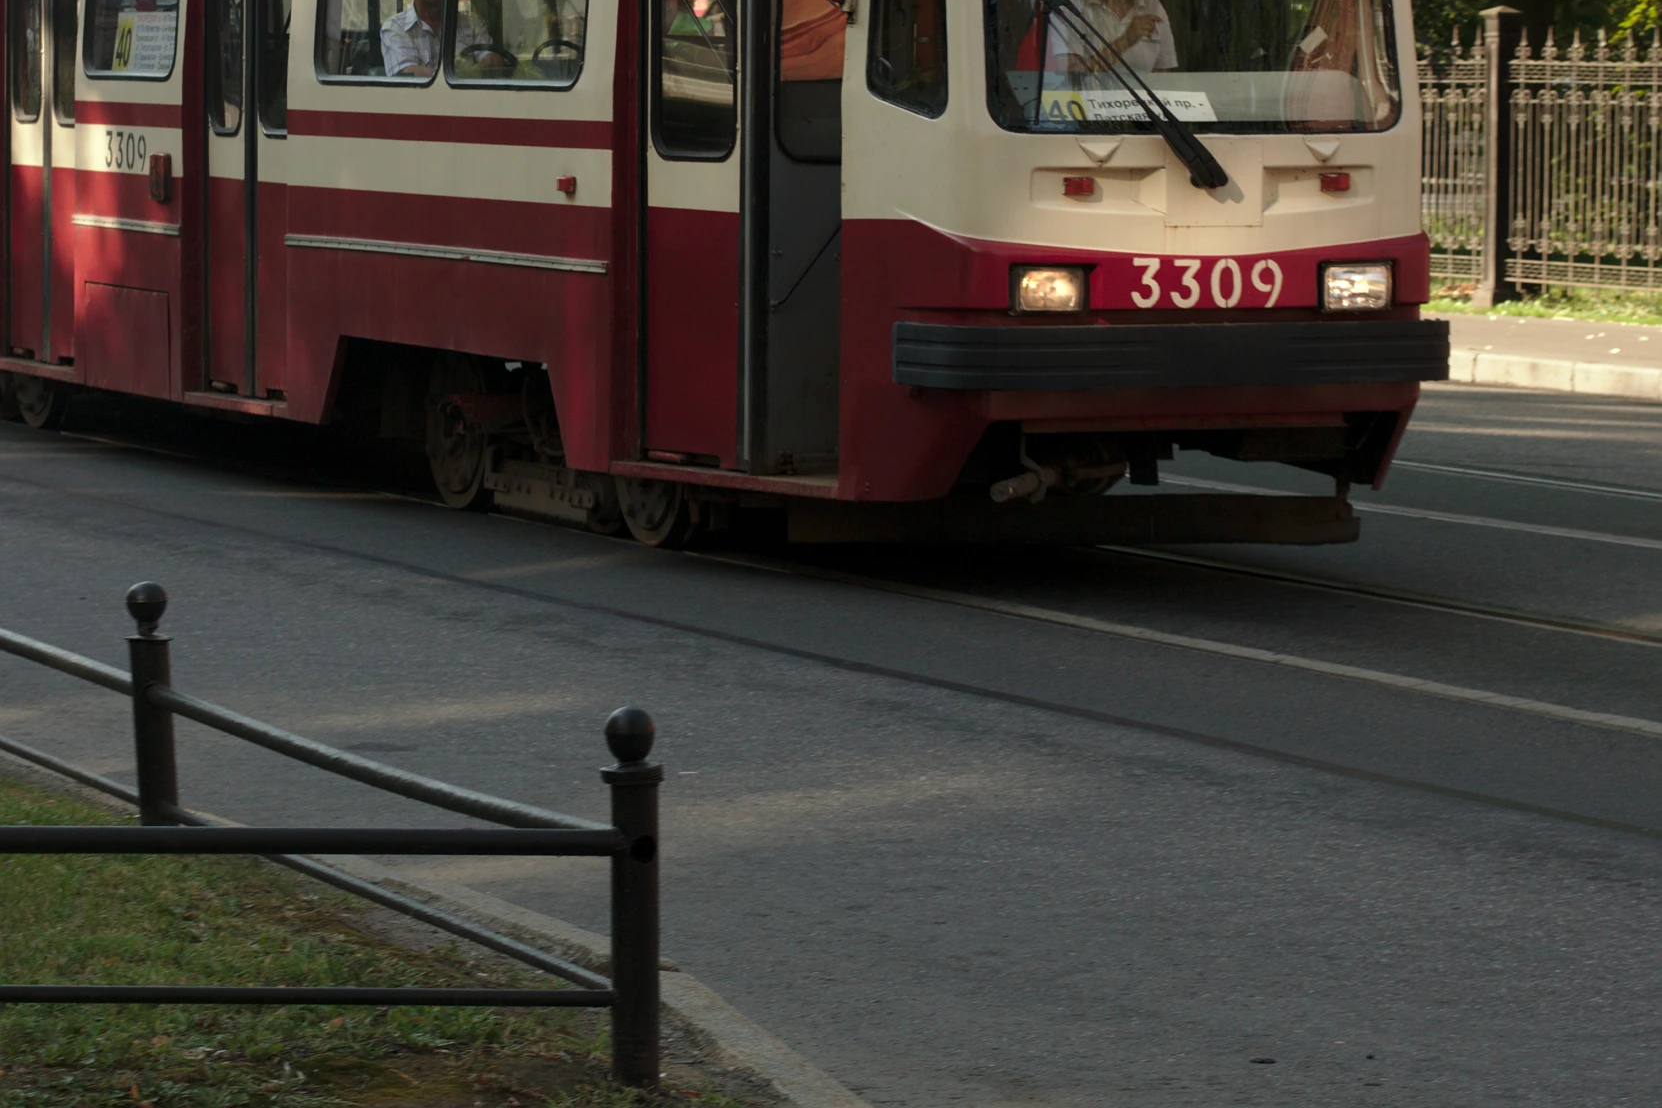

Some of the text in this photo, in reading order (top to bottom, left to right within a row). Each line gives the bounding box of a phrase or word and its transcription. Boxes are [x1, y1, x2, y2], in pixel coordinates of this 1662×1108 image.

[115, 27, 132, 67] 40
[1048, 99, 1088, 121] 40
[1174, 99, 1197, 110] пр.
[104, 130, 147, 173] 3309
[1131, 257, 1283, 308] 3309
